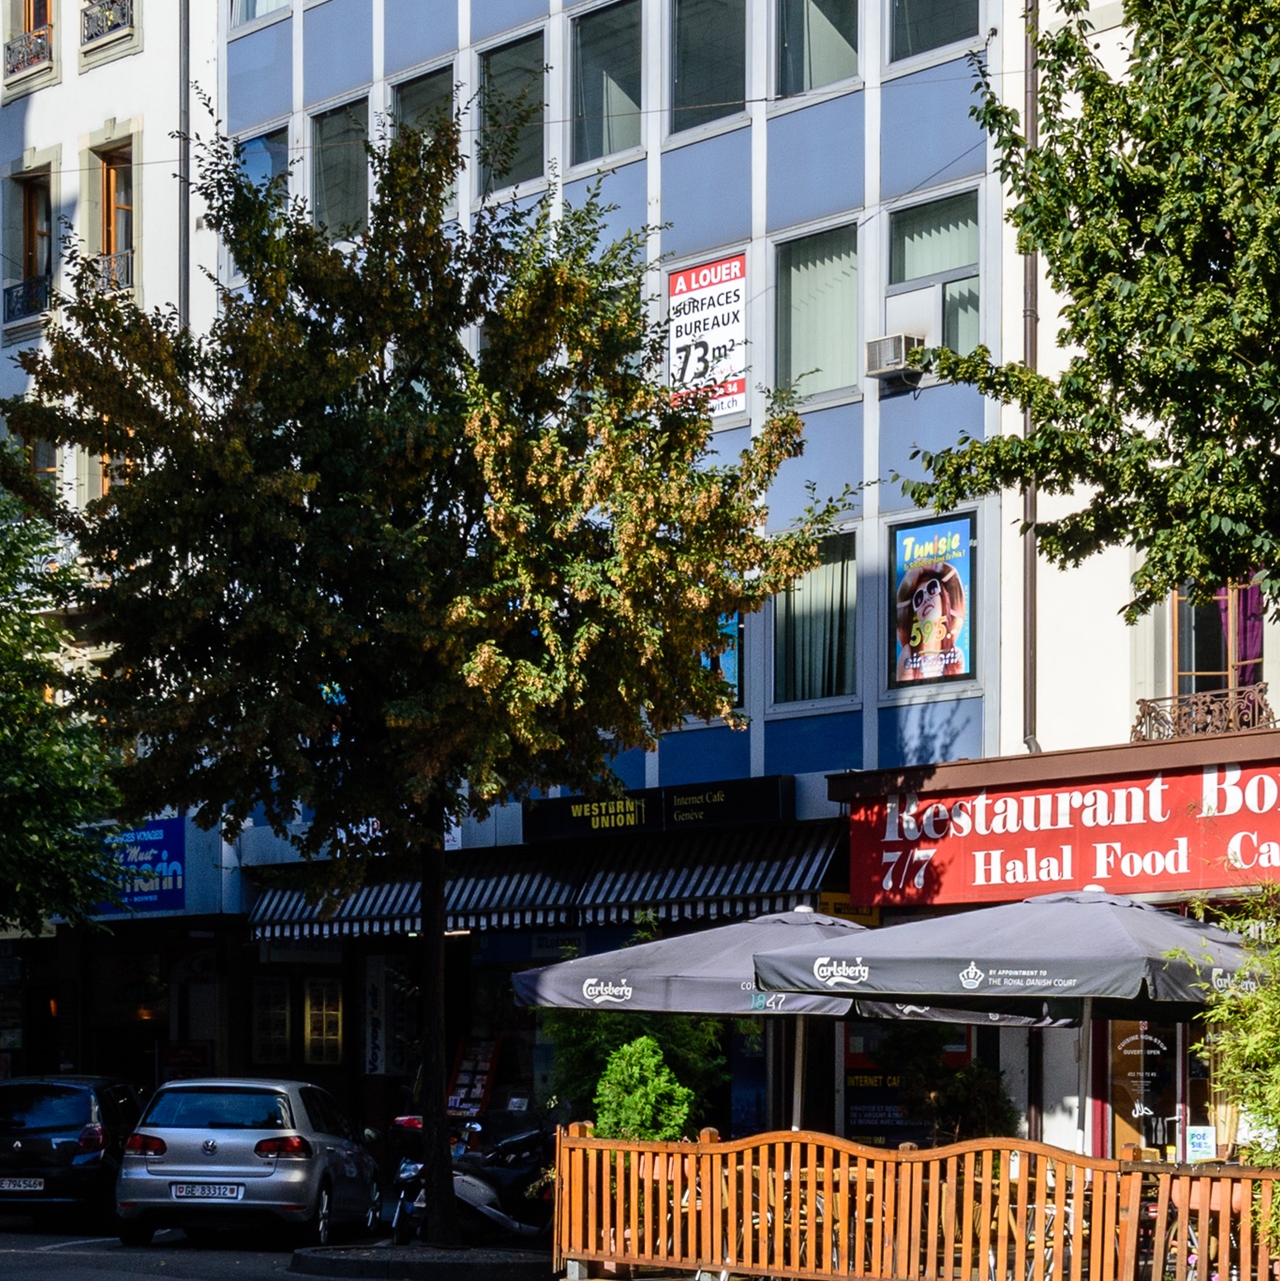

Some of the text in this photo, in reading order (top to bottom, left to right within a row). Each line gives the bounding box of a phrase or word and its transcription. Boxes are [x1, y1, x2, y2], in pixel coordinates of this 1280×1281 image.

[675, 261, 741, 294] A LOUER
[673, 289, 740, 318] SURFACES
[675, 310, 740, 338] BUREAUX
[676, 340, 710, 382] 73
[903, 531, 960, 561] Tunisie
[571, 799, 634, 817] WESTERN
[674, 790, 725, 806] Internet Café
[881, 772, 1170, 842] Restaurant
[591, 813, 635, 829] UNION
[673, 809, 704, 822] Genève
[882, 847, 937, 891] 7/7
[972, 845, 1074, 885] Halal
[1092, 837, 1190, 879] Food
[813, 957, 869, 986] Carlsberg
[988, 978, 1002, 986] THE
[1003, 978, 1024, 986] ROYAL
[1053, 979, 1078, 987] COURT
[582, 978, 633, 1004] Carlsberg
[751, 993, 786, 1010] 1847
[1117, 1034, 1139, 1051] CUISINE
[848, 1075, 902, 1087] INTERNET CAF
[201, 1186, 229, 1196] 83312
